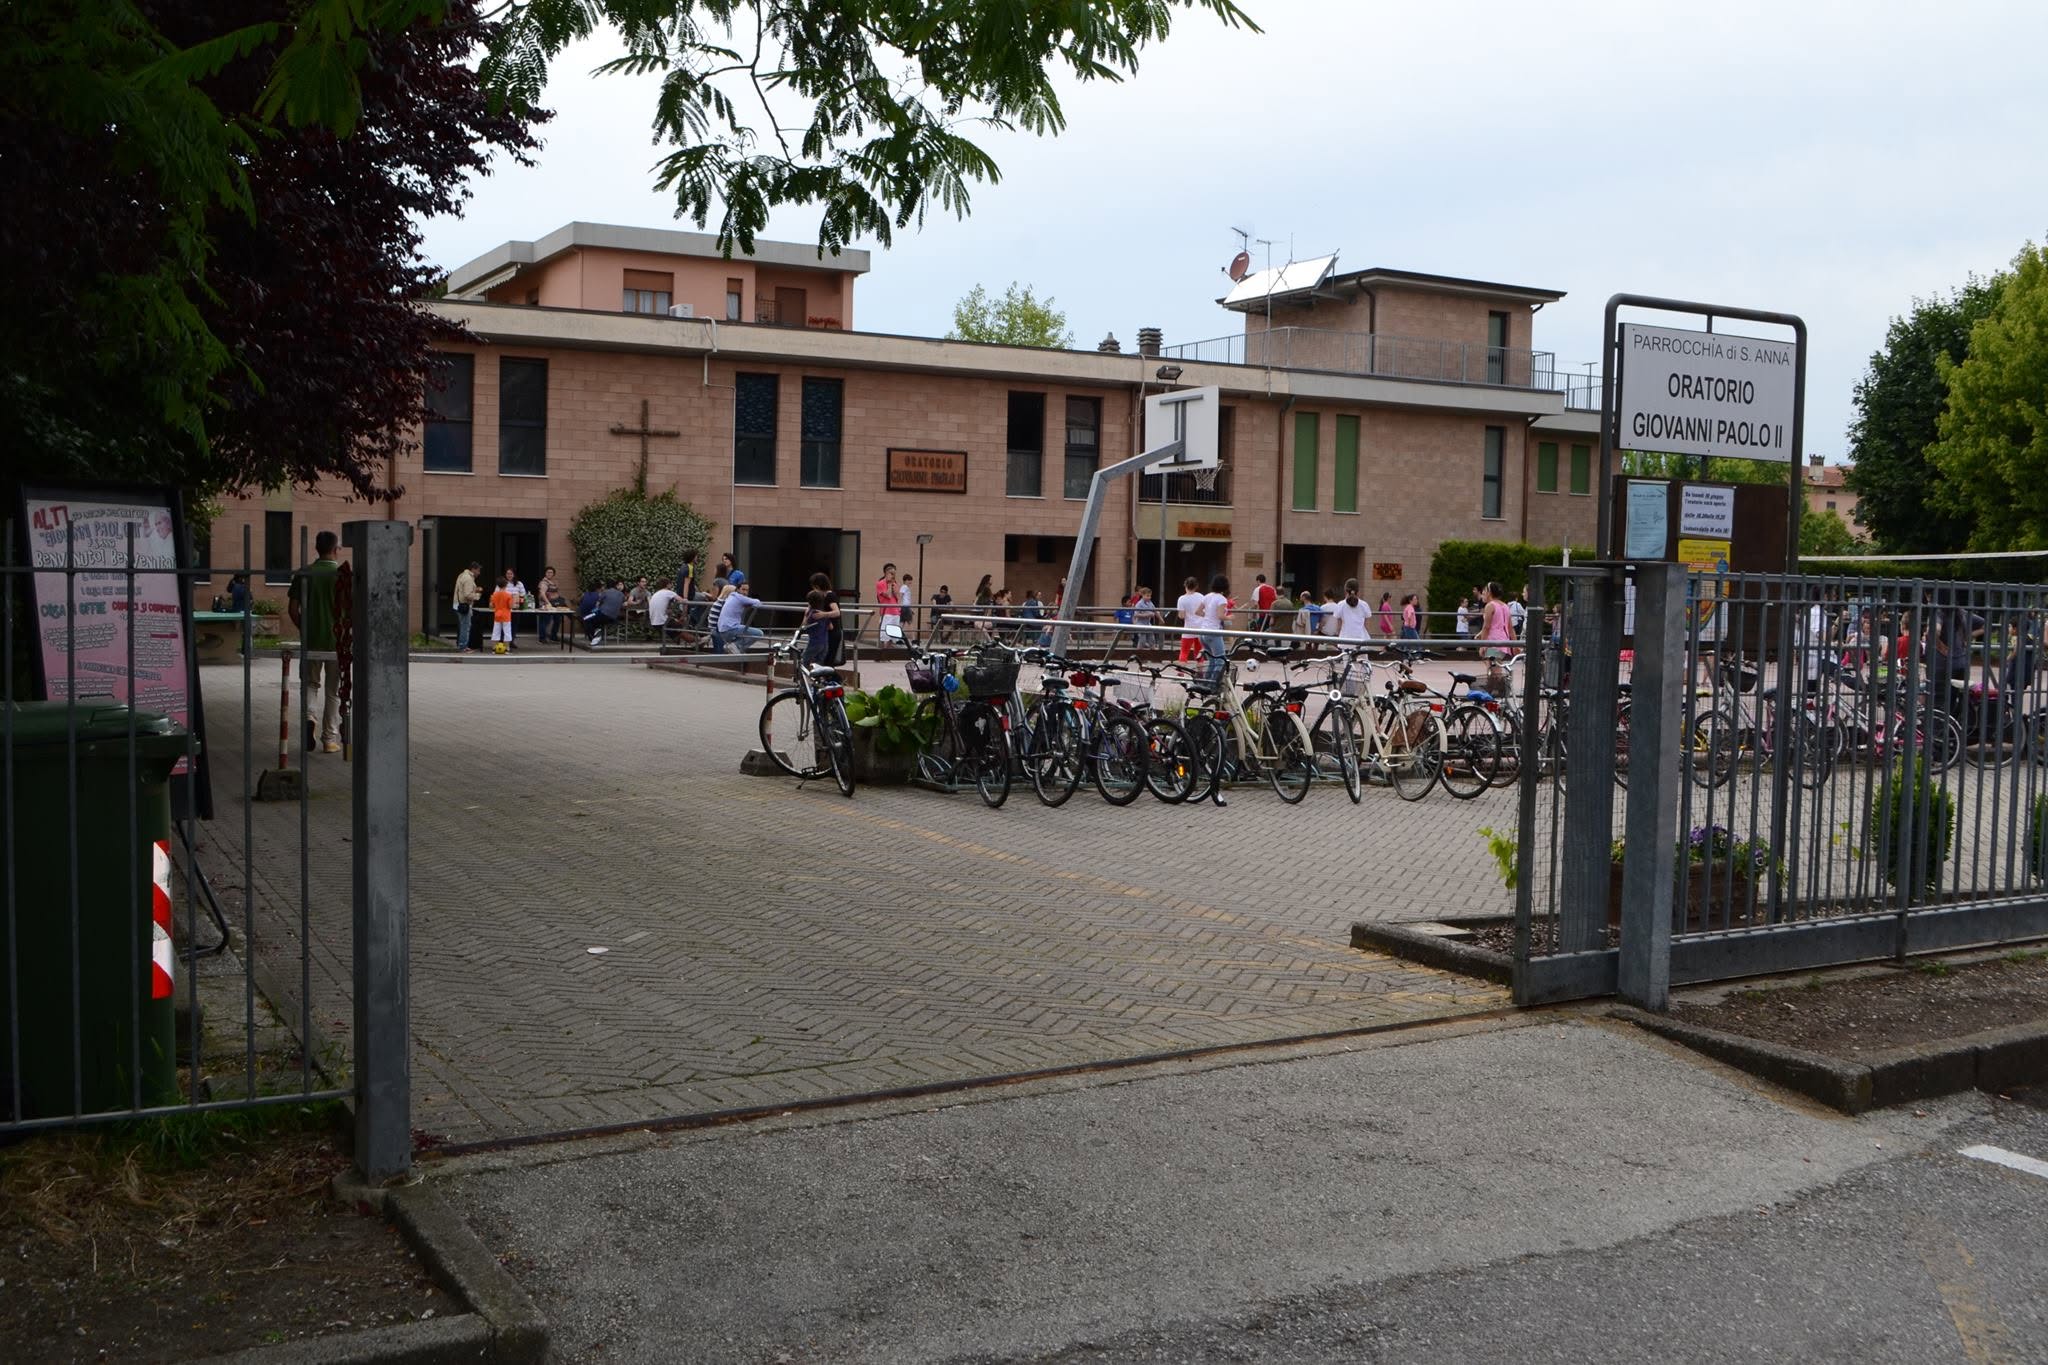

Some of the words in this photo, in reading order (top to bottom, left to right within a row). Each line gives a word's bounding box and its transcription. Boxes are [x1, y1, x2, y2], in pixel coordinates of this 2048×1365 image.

[1633, 333, 1724, 359] PARROCCHIA
[1726, 347, 1737, 360] di
[1740, 346, 1752, 362] S.
[1754, 348, 1790, 366] ANNA
[1668, 372, 1755, 405] ORATORIO
[1632, 411, 1713, 443] GIOVANNI
[1716, 419, 1771, 448] PAOLO
[1774, 424, 1783, 449] II
[904, 455, 953, 469] ORATORIO
[1194, 527, 1232, 537] ENTRATA
